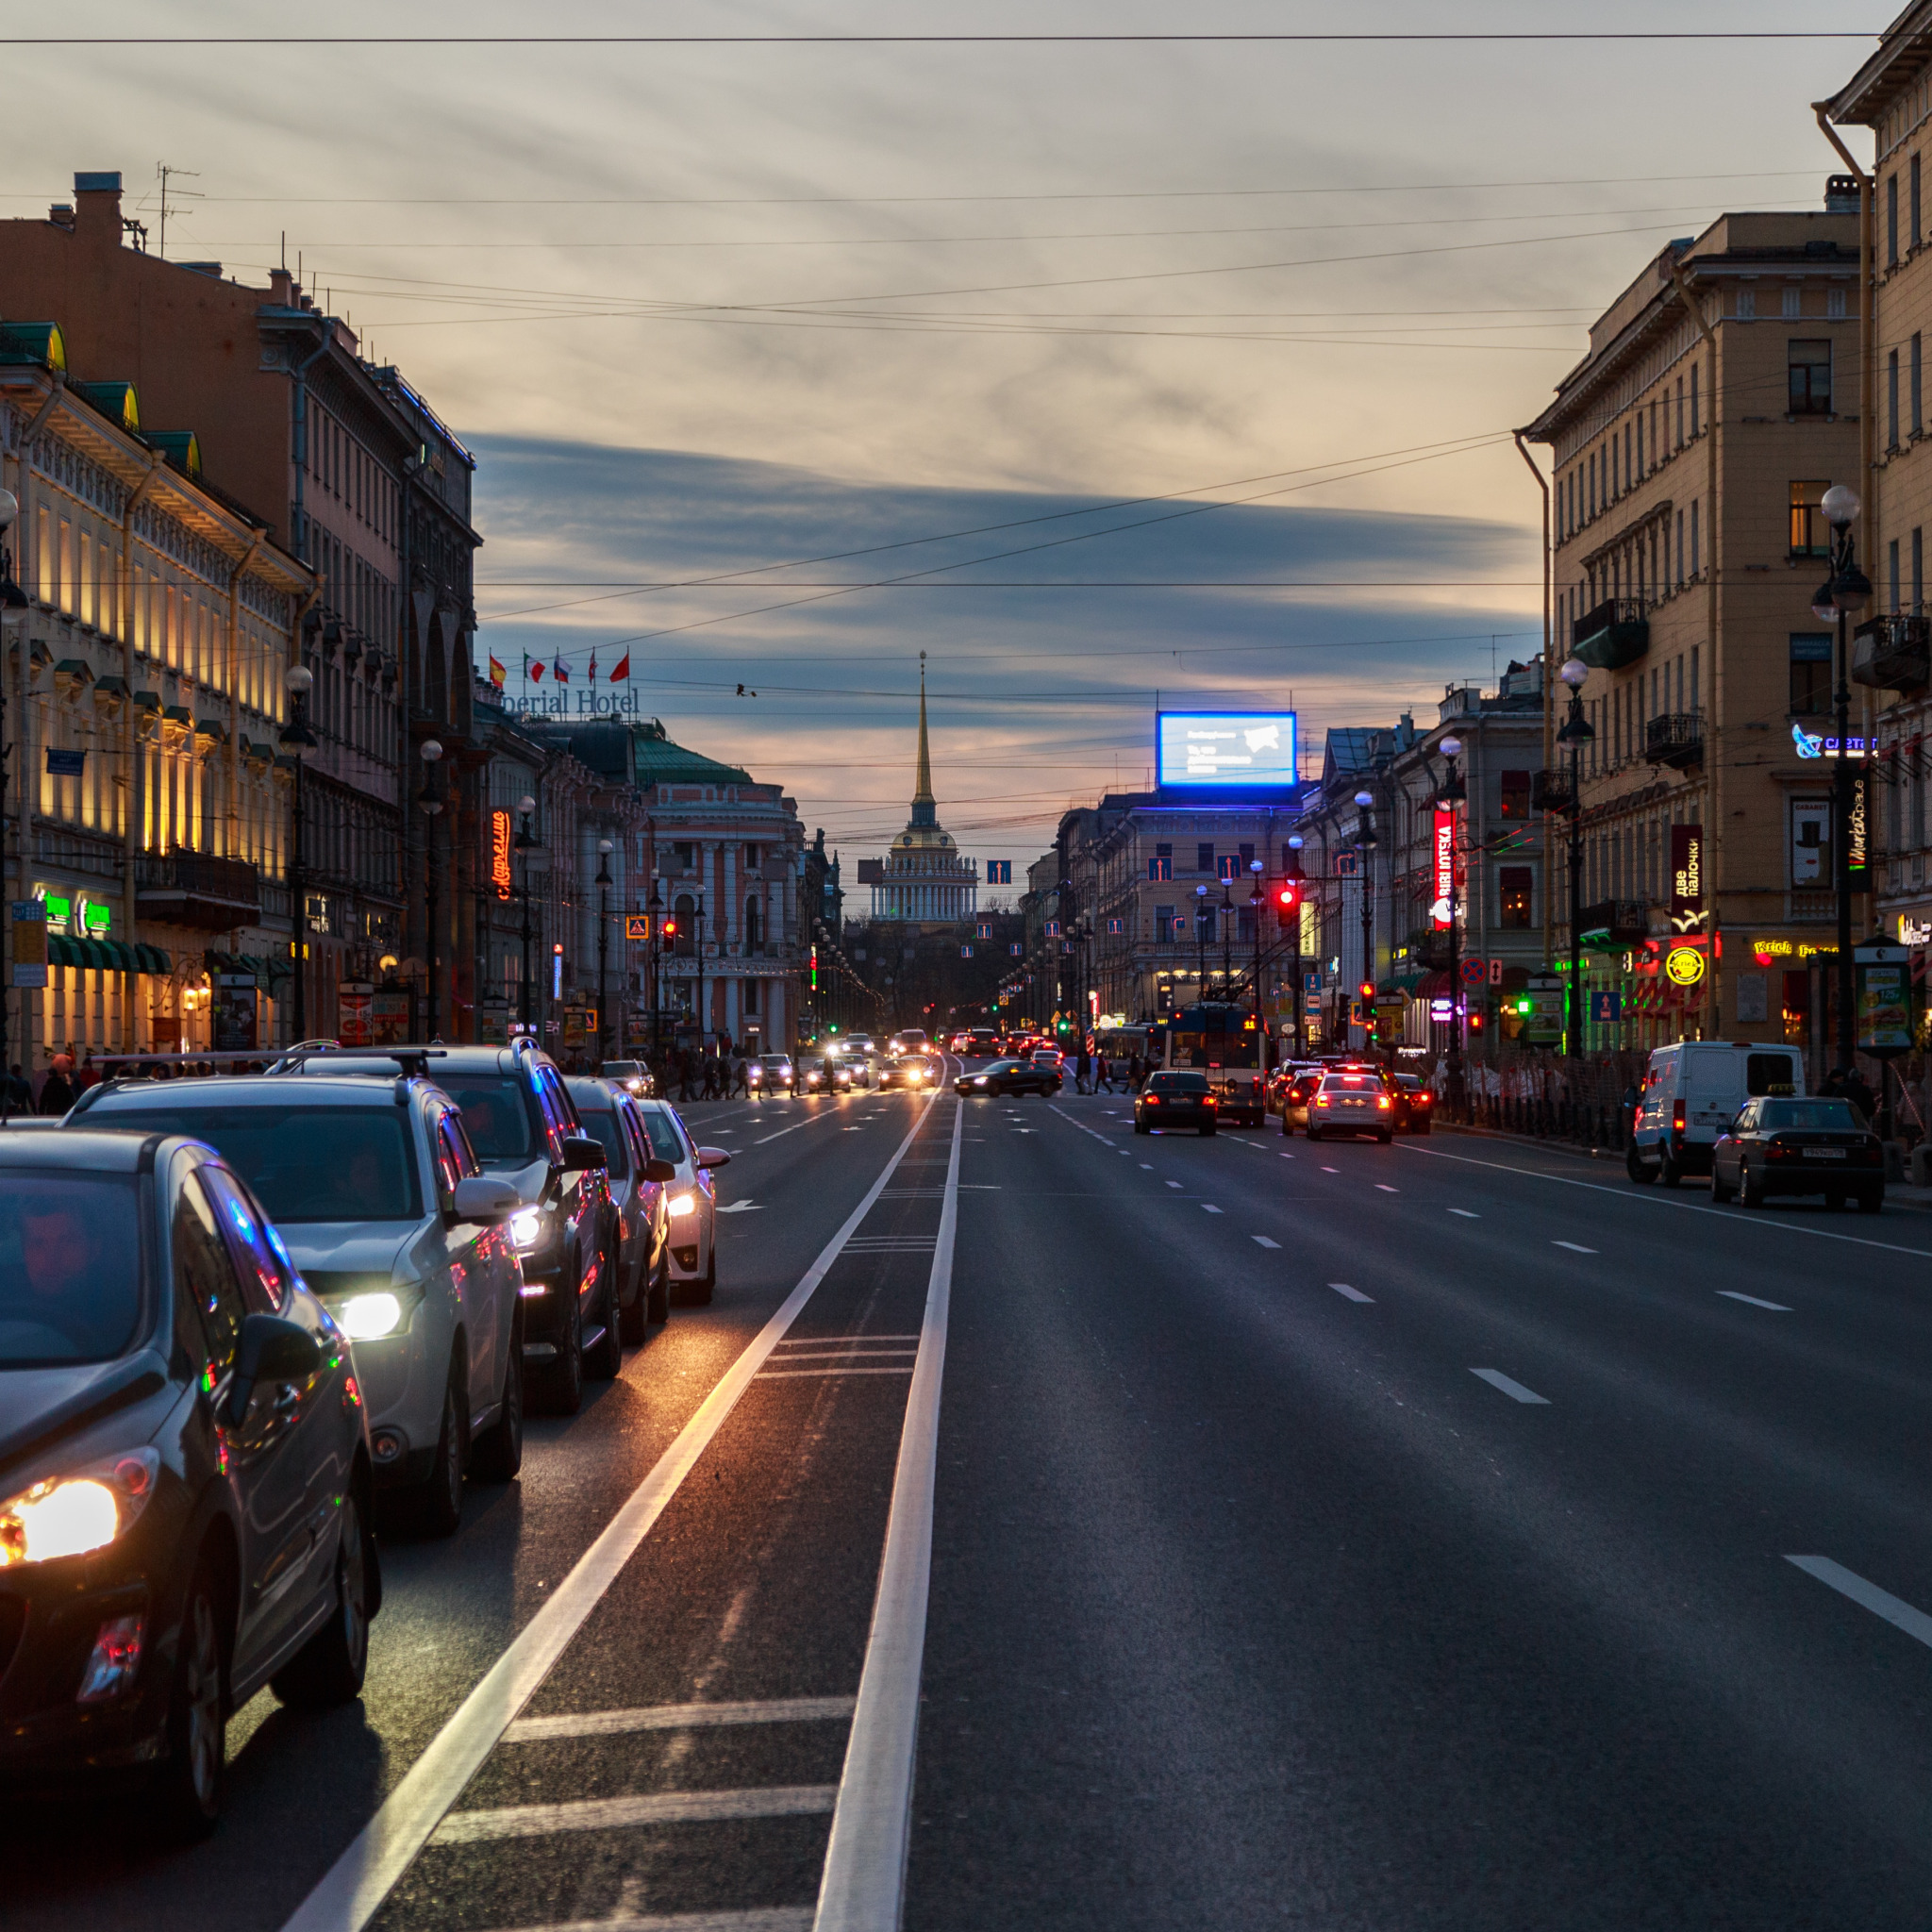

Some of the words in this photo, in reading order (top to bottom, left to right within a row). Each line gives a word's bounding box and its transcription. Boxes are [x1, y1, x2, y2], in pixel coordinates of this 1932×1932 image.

[576, 688, 641, 714] Hotel
[1689, 838, 1699, 897] палочки
[1676, 870, 1689, 897] две
[1243, 1020, 1256, 1030] 11
